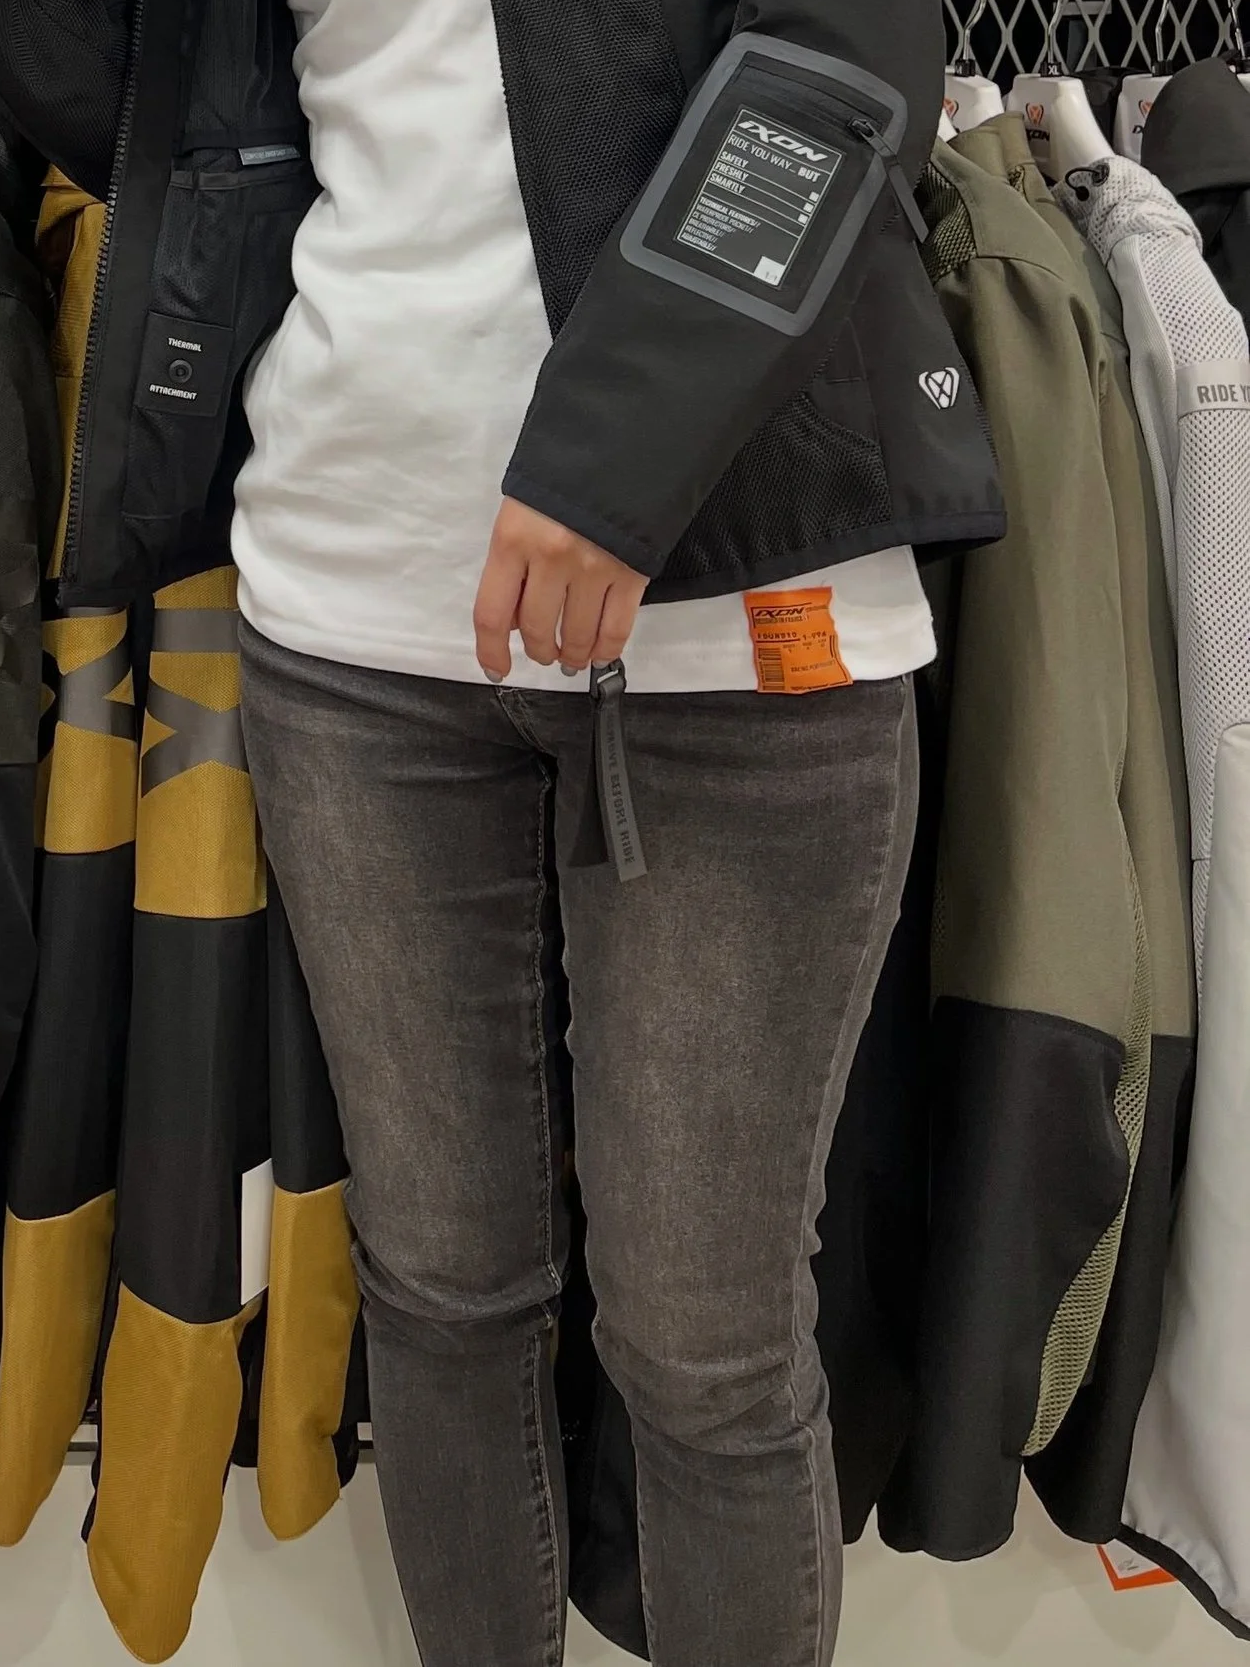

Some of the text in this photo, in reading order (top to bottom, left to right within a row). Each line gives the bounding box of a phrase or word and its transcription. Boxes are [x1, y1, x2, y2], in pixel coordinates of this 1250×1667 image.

[720, 151, 749, 168] SAFELY
[728, 134, 751, 152] RIDE
[797, 166, 821, 183] BUT
[715, 161, 749, 181] FRESHLY
[710, 173, 746, 194] SMARTLY
[168, 337, 202, 352] THERMAL
[150, 384, 198, 401] ATTACHMENT
[1197, 384, 1238, 404] RIDE
